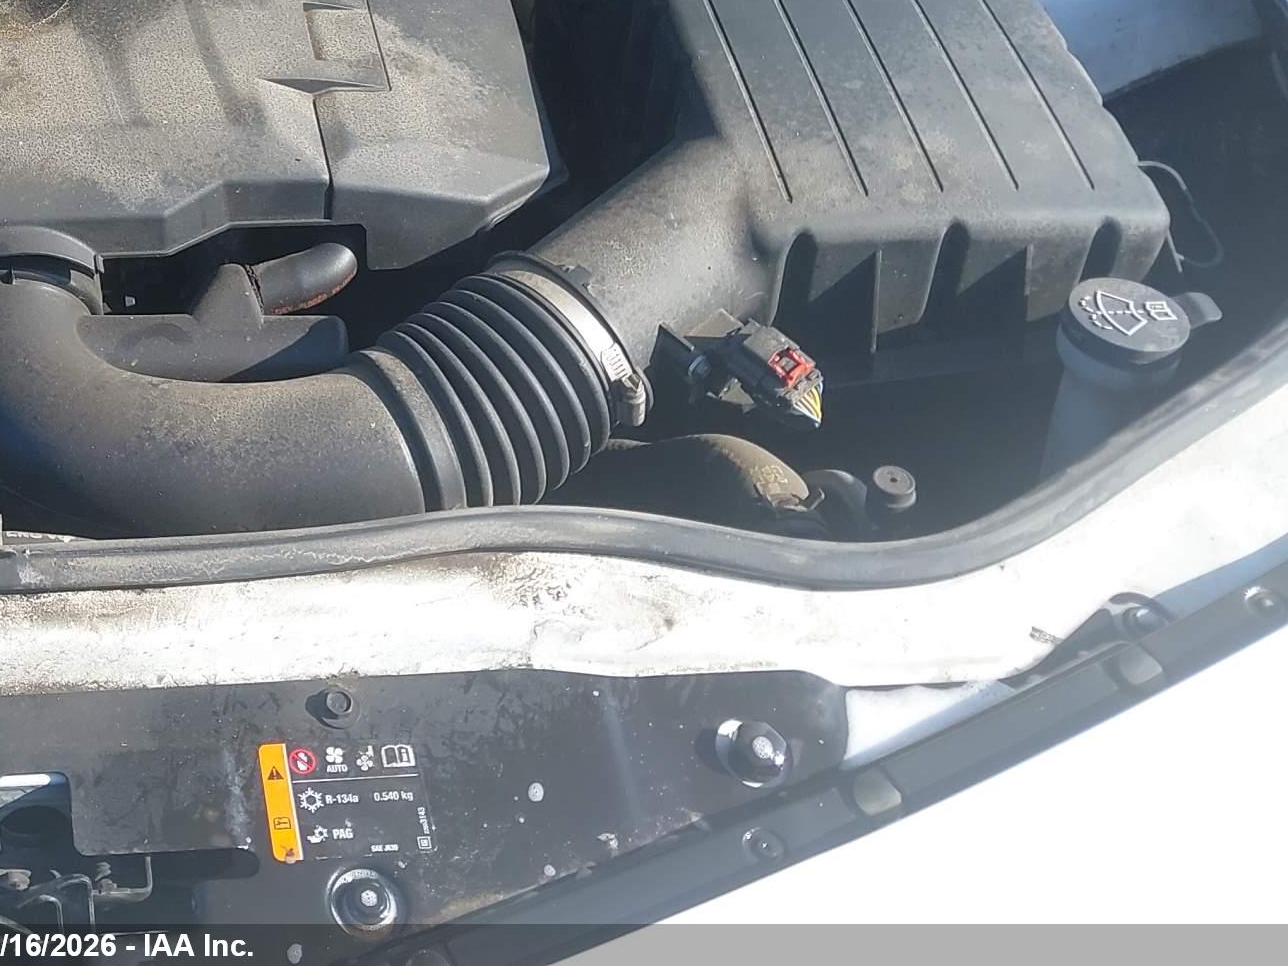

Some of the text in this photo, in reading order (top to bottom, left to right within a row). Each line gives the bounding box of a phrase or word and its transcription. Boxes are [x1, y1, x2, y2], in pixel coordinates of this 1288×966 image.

[326, 764, 348, 774] AUTO
[325, 790, 414, 805] R-134a 0.540 kg
[332, 828, 354, 839] PAG
